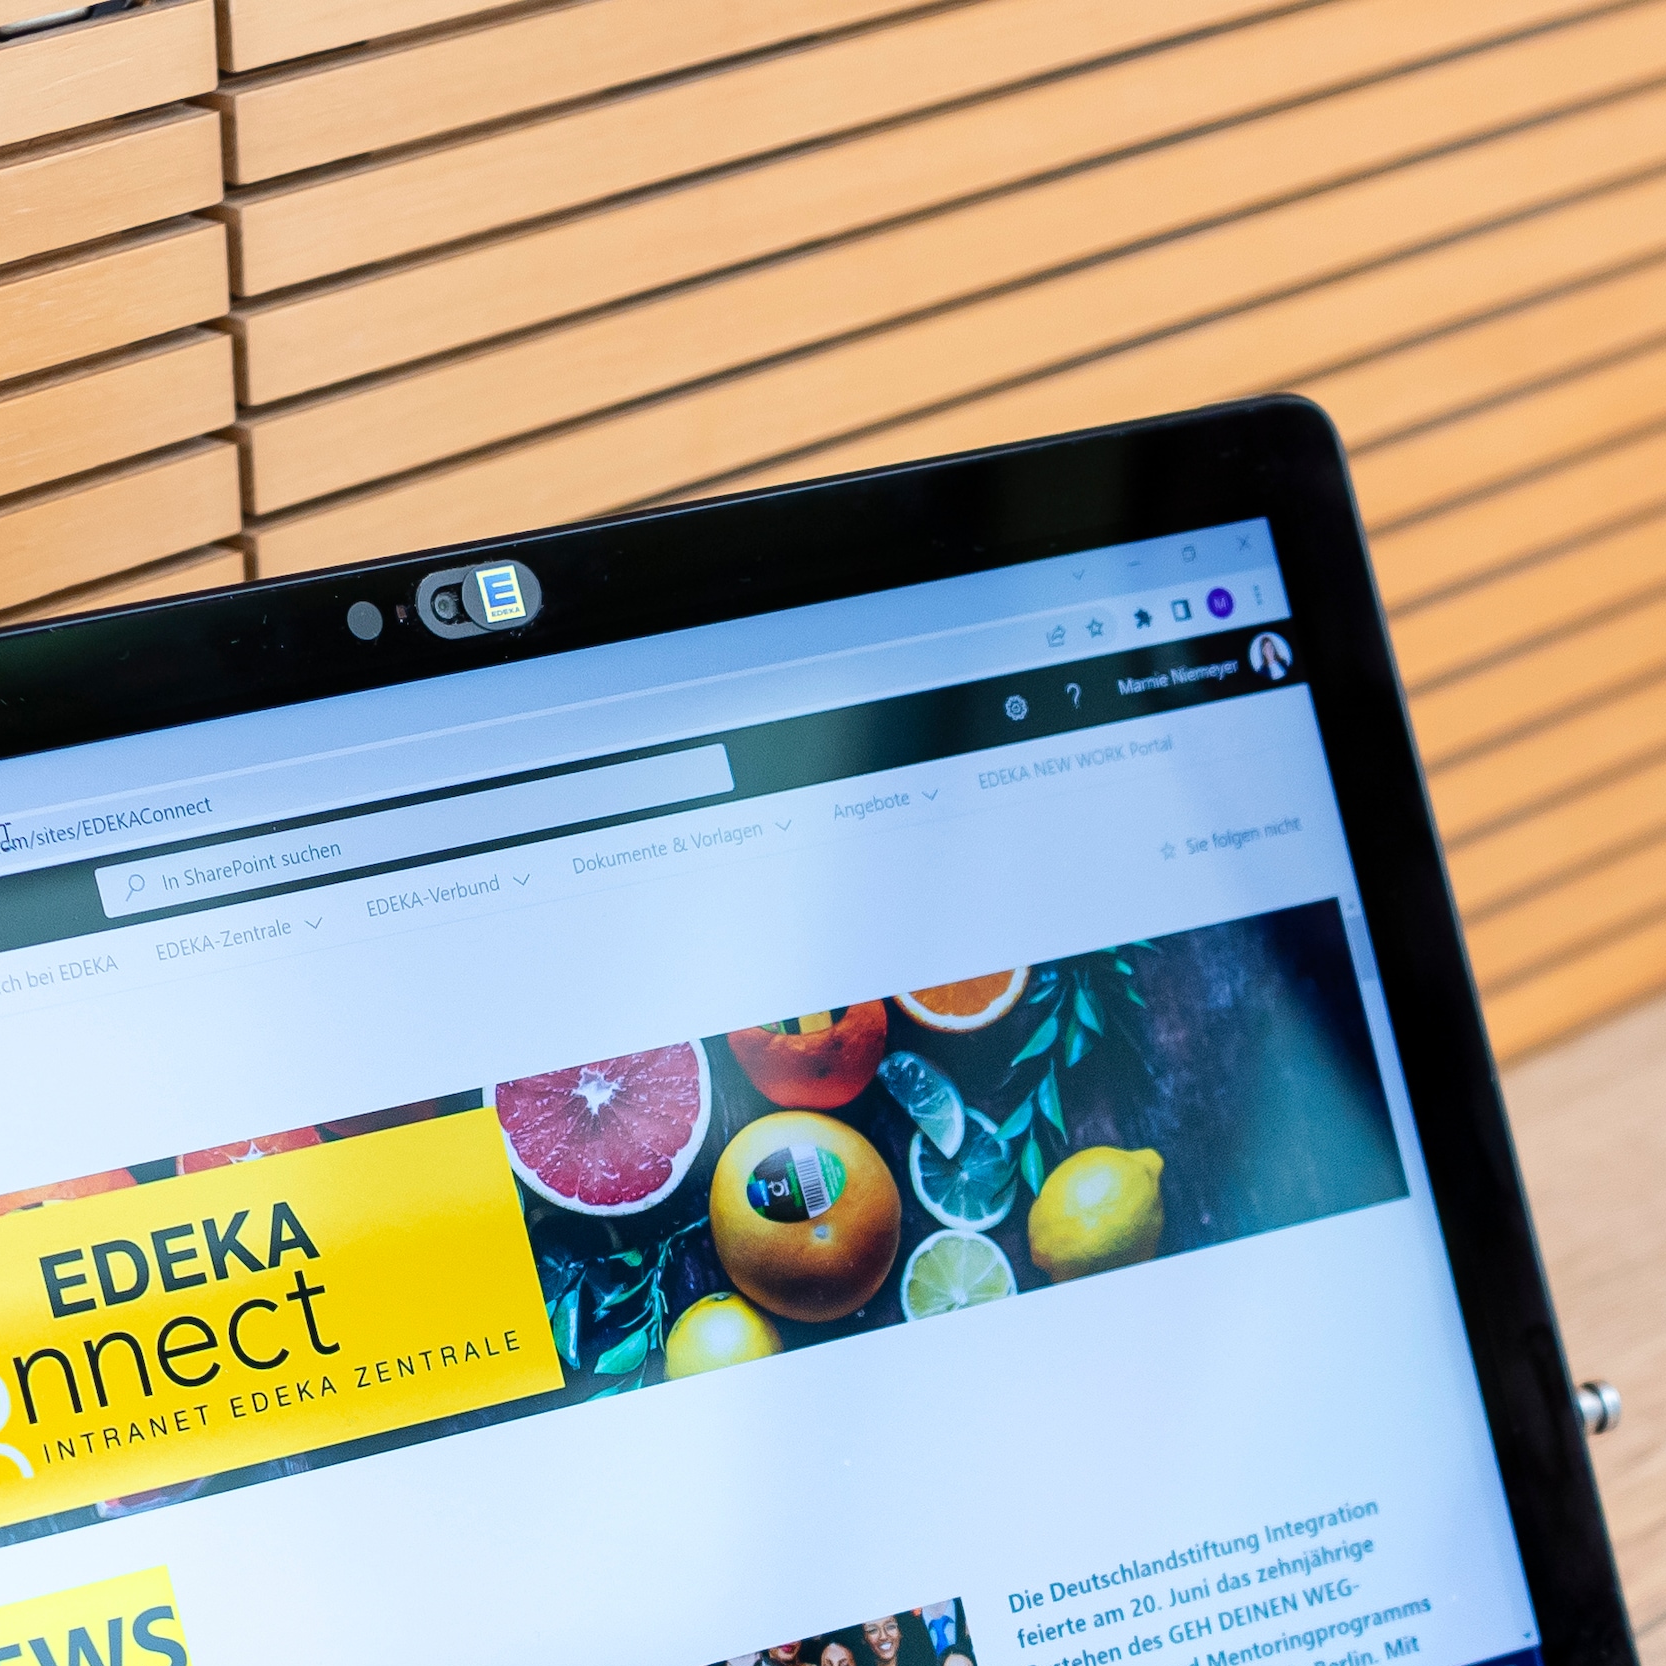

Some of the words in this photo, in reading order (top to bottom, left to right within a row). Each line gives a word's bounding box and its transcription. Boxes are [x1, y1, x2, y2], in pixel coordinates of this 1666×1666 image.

[491, 606, 520, 617] EDEKA
[1170, 660, 1238, 685] Niemeyer
[978, 764, 1030, 790] EDEKA
[1033, 756, 1071, 778] NEW
[1075, 745, 1125, 769] WORK
[1128, 735, 1173, 758] Portal
[833, 791, 911, 820] Angebote
[572, 840, 668, 875] Dokumente
[672, 836, 687, 853] &
[691, 821, 763, 852] Vorlagen
[1185, 838, 1209, 855] Sie
[1212, 827, 1260, 850] folgen
[1264, 816, 1302, 839] nicht
[162, 873, 180, 890] In
[184, 855, 277, 887] SharePoint
[281, 841, 342, 867] suchen
[366, 874, 501, 918] EDEKA-Verbund
[155, 918, 292, 962] EDEKA-Zentrale
[28, 967, 55, 988] bei
[60, 956, 119, 983] EDEKA
[38, 1200, 321, 1319] EDEKA
[41, 1404, 212, 1465] INTRANET
[230, 1374, 339, 1421] EDEKA
[355, 1328, 523, 1389] ZENTRALE
[1008, 1588, 1045, 1614] Die
[1049, 1532, 1261, 1603] Deutschlandstiftung
[1265, 1498, 1379, 1544] Integration
[1018, 1614, 1087, 1650] feierte
[1092, 1605, 1125, 1628] am
[1131, 1596, 1163, 1619] 20.
[1168, 1582, 1211, 1612] Juni
[1216, 1569, 1252, 1596] das
[1256, 1536, 1375, 1586] zehnjährige
[1127, 1632, 1164, 1658] des
[1168, 1617, 1213, 1646] GEH
[1218, 1593, 1299, 1632] DEINEN
[1302, 1580, 1361, 1613] WEG-
[1384, 1636, 1420, 1664] Mit
